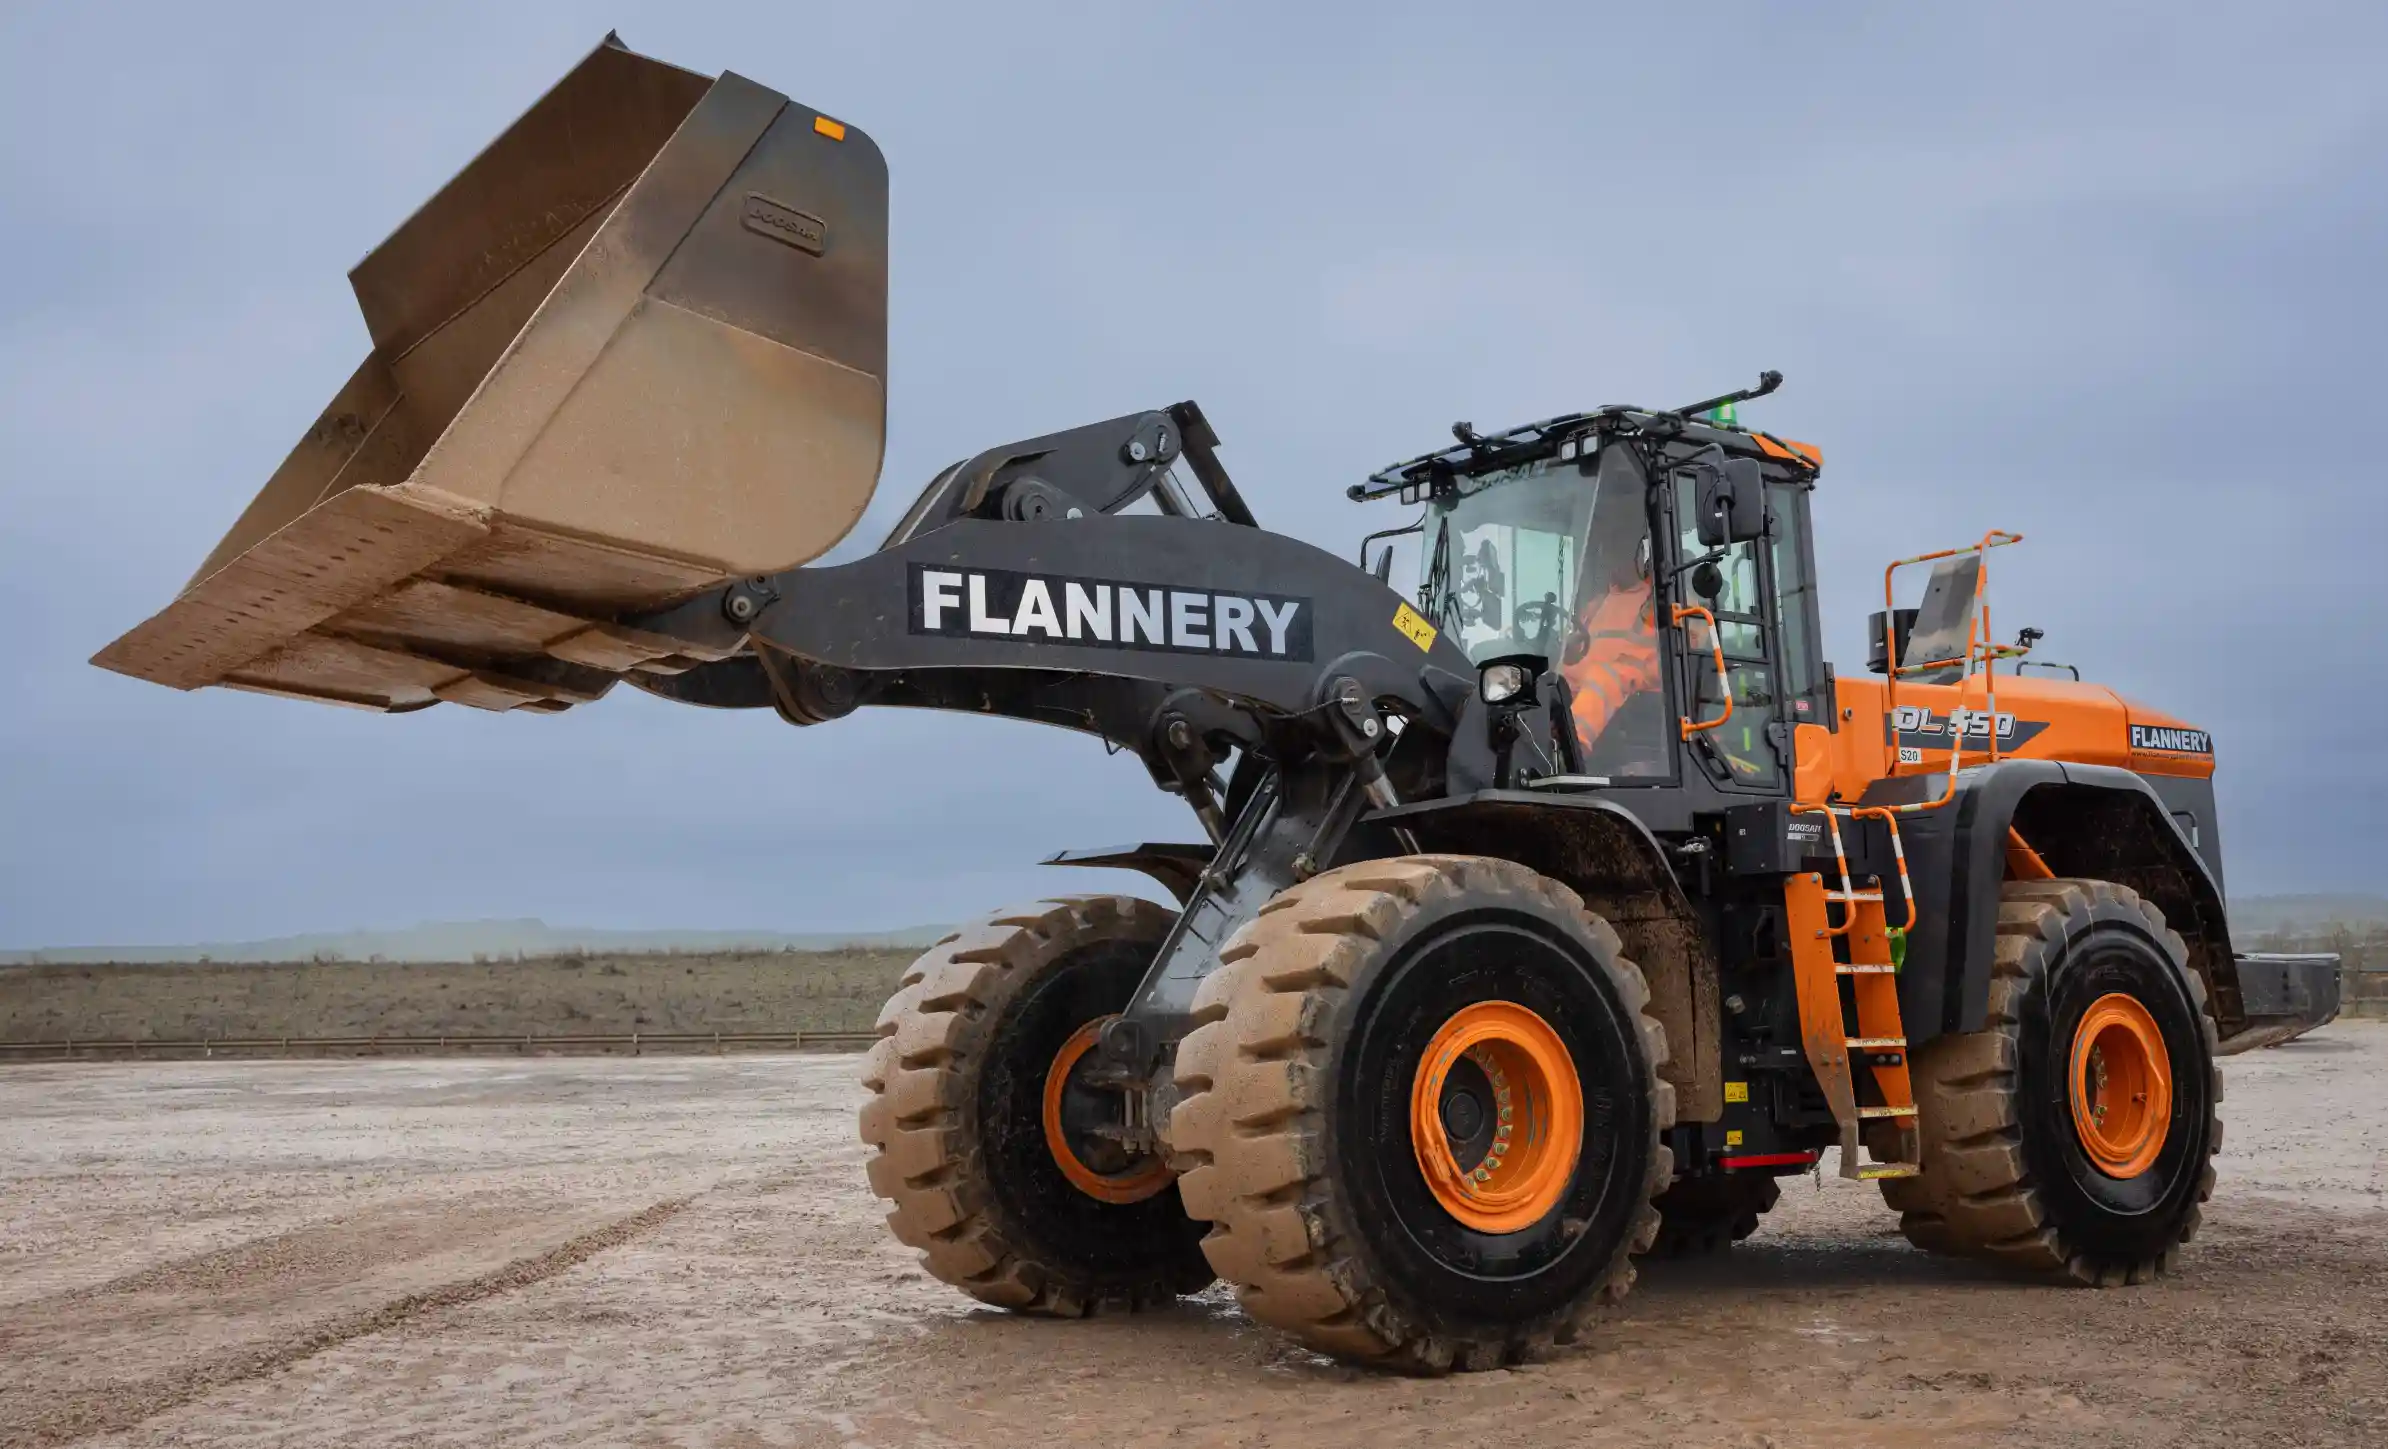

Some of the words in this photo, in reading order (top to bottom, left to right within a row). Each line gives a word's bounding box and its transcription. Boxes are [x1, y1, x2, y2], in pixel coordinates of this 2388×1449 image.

[923, 570, 1300, 654] FLANNERY
[1892, 705, 1944, 735] DL
[2131, 726, 2208, 752] FLANNERY
[1900, 750, 1918, 762] S20
